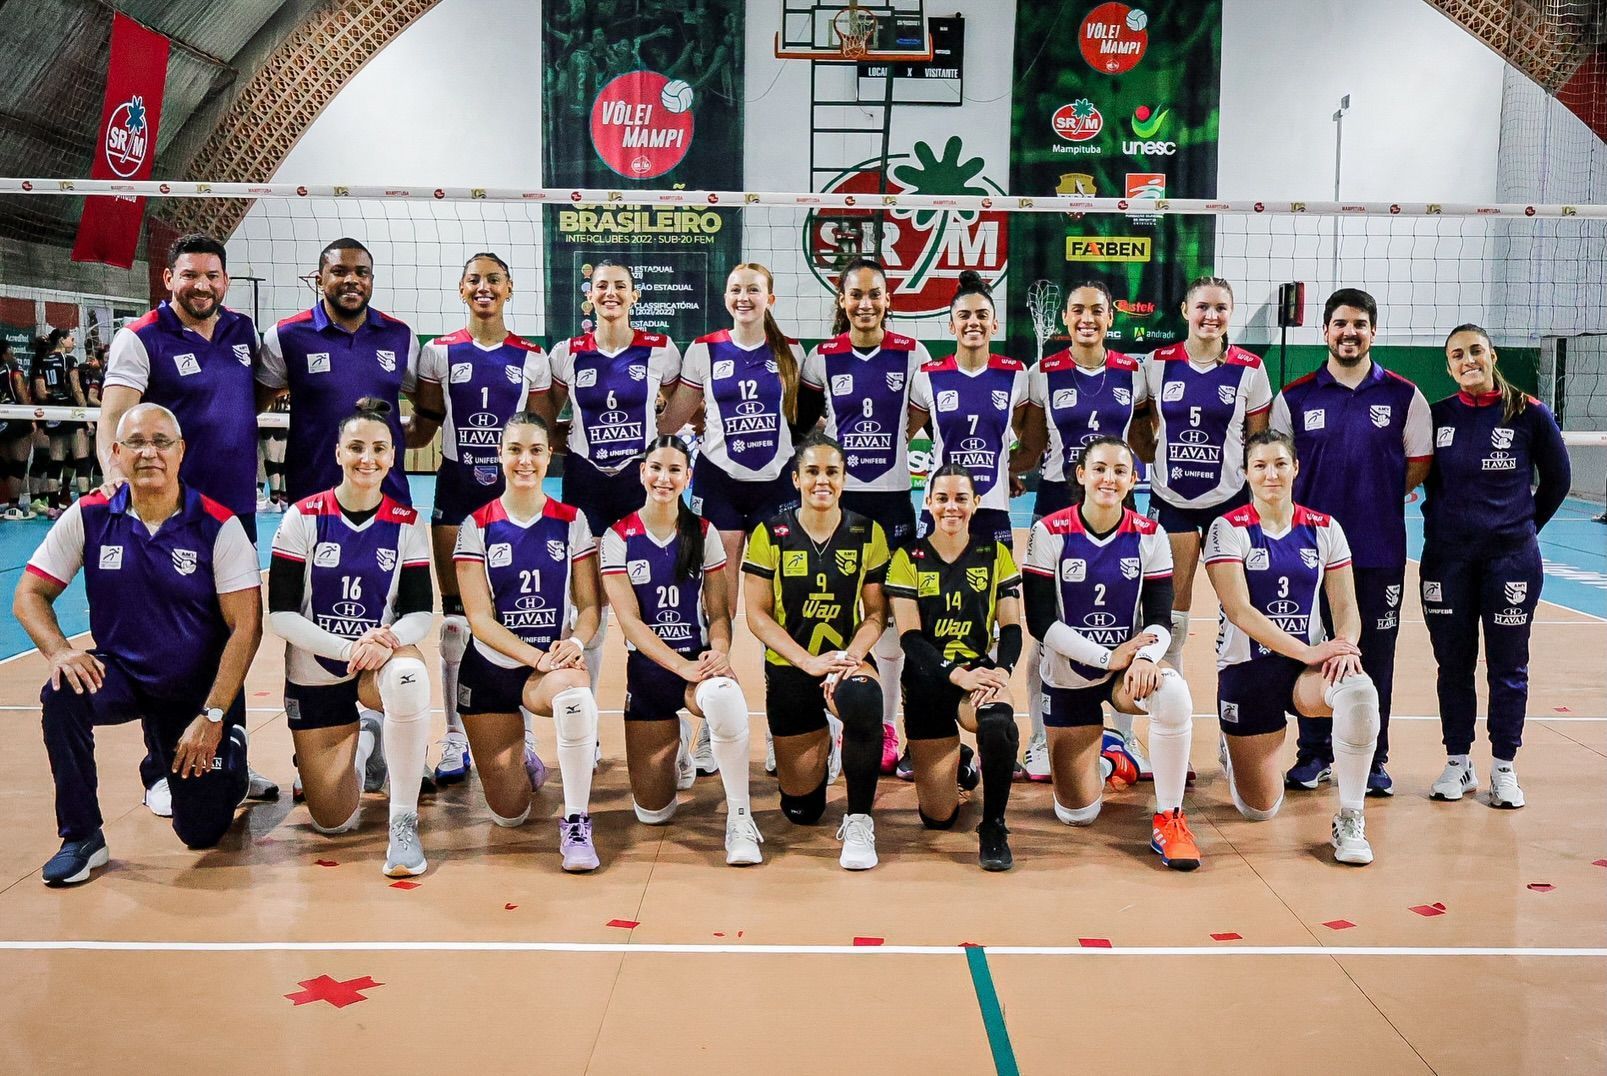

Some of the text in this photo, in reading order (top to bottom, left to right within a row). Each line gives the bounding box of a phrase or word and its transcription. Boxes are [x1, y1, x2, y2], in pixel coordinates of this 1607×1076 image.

[1087, 22, 1120, 39] VÔLEI
[1100, 40, 1141, 55] MAMPI
[924, 67, 959, 79] VISITANTE
[602, 100, 653, 126] VÔLEI
[622, 127, 684, 148] MAMPI
[1052, 144, 1102, 155] Mampituba
[1122, 140, 1177, 156] unesc
[559, 210, 723, 234] BRASILEIRO
[565, 234, 715, 244] INTERCLUBES 2022 SUB-20 FEM
[1071, 241, 1146, 257] FARBEN
[634, 265, 675, 273] ESTADUAL
[653, 284, 694, 292] ESTADUAL
[635, 301, 700, 310] CLASSIFICATÓRIA
[631, 320, 670, 328] ESTADUAL
[1146, 329, 1176, 339] andrade
[45, 369, 58, 386] 10
[480, 386, 489, 409] 1
[737, 379, 759, 400] 12
[606, 390, 618, 410] 6
[862, 397, 873, 418] 8
[726, 416, 776, 433] HAVAN
[967, 414, 979, 435] 7
[1087, 410, 1100, 431] 4
[1189, 406, 1202, 427] 5
[590, 425, 642, 441] HAVAN
[843, 436, 891, 448] HAVAN
[950, 453, 994, 465] HAVAN
[1169, 446, 1220, 461] HAVAN
[1482, 459, 1516, 470] HAVAN
[1184, 470, 1214, 479] UNIFEBE
[1027, 525, 1038, 556] HAVAN
[1213, 523, 1221, 553] HAVAN
[341, 576, 362, 601] 16
[519, 569, 541, 593] 21
[816, 572, 827, 593] 9
[1277, 576, 1289, 598] 3
[656, 585, 680, 609] 20
[945, 591, 962, 612] 14
[1094, 583, 1106, 606] 2
[503, 611, 556, 626] HAVAN
[801, 599, 841, 623] Wap
[1494, 613, 1528, 624] HAVAN
[934, 618, 973, 640] Wap
[1272, 618, 1308, 631] VAN
